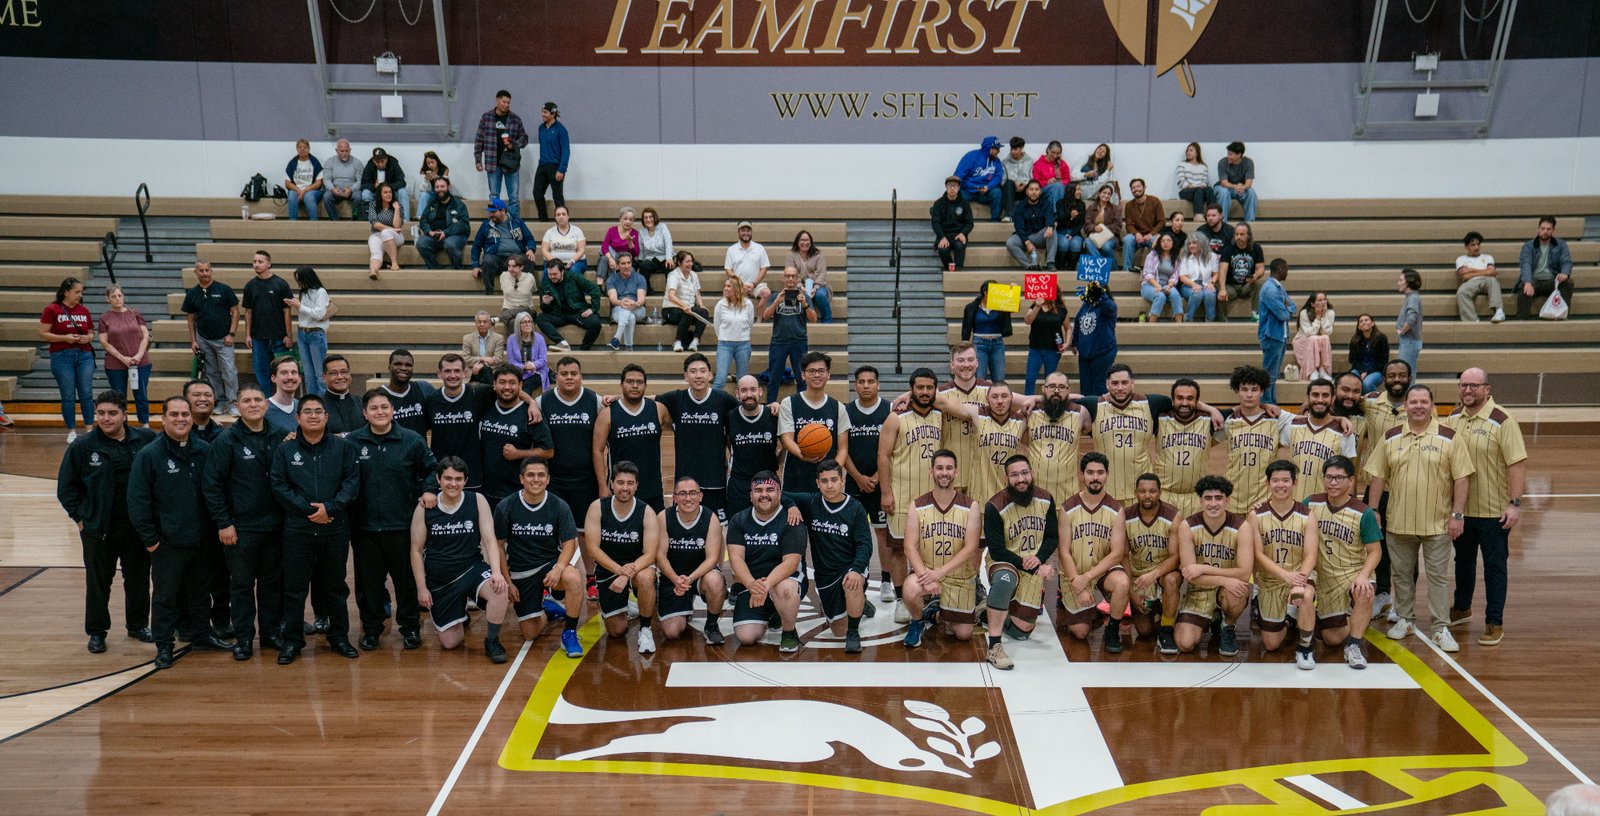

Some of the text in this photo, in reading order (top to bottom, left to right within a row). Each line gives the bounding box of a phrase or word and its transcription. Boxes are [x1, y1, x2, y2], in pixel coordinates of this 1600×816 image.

[771, 91, 1039, 119] WWW.SFHS.NET
[1099, 415, 1148, 434] CAPUCHINS
[1031, 424, 1074, 444] CAPUCHINS
[1115, 433, 1134, 448] 34
[1162, 432, 1206, 450] CAPUCHINS
[1230, 432, 1274, 452] CAPUCHINS
[921, 444, 935, 459] 25
[991, 451, 1008, 466] 42
[1046, 444, 1055, 458] 3
[1176, 451, 1190, 466] 12
[1243, 452, 1258, 466] 13
[1302, 460, 1313, 476] 11
[935, 540, 952, 556] 22
[1021, 534, 1036, 552] 20
[1324, 540, 1333, 554] 5
[1146, 550, 1154, 562] 4
[1276, 548, 1288, 564] 17
